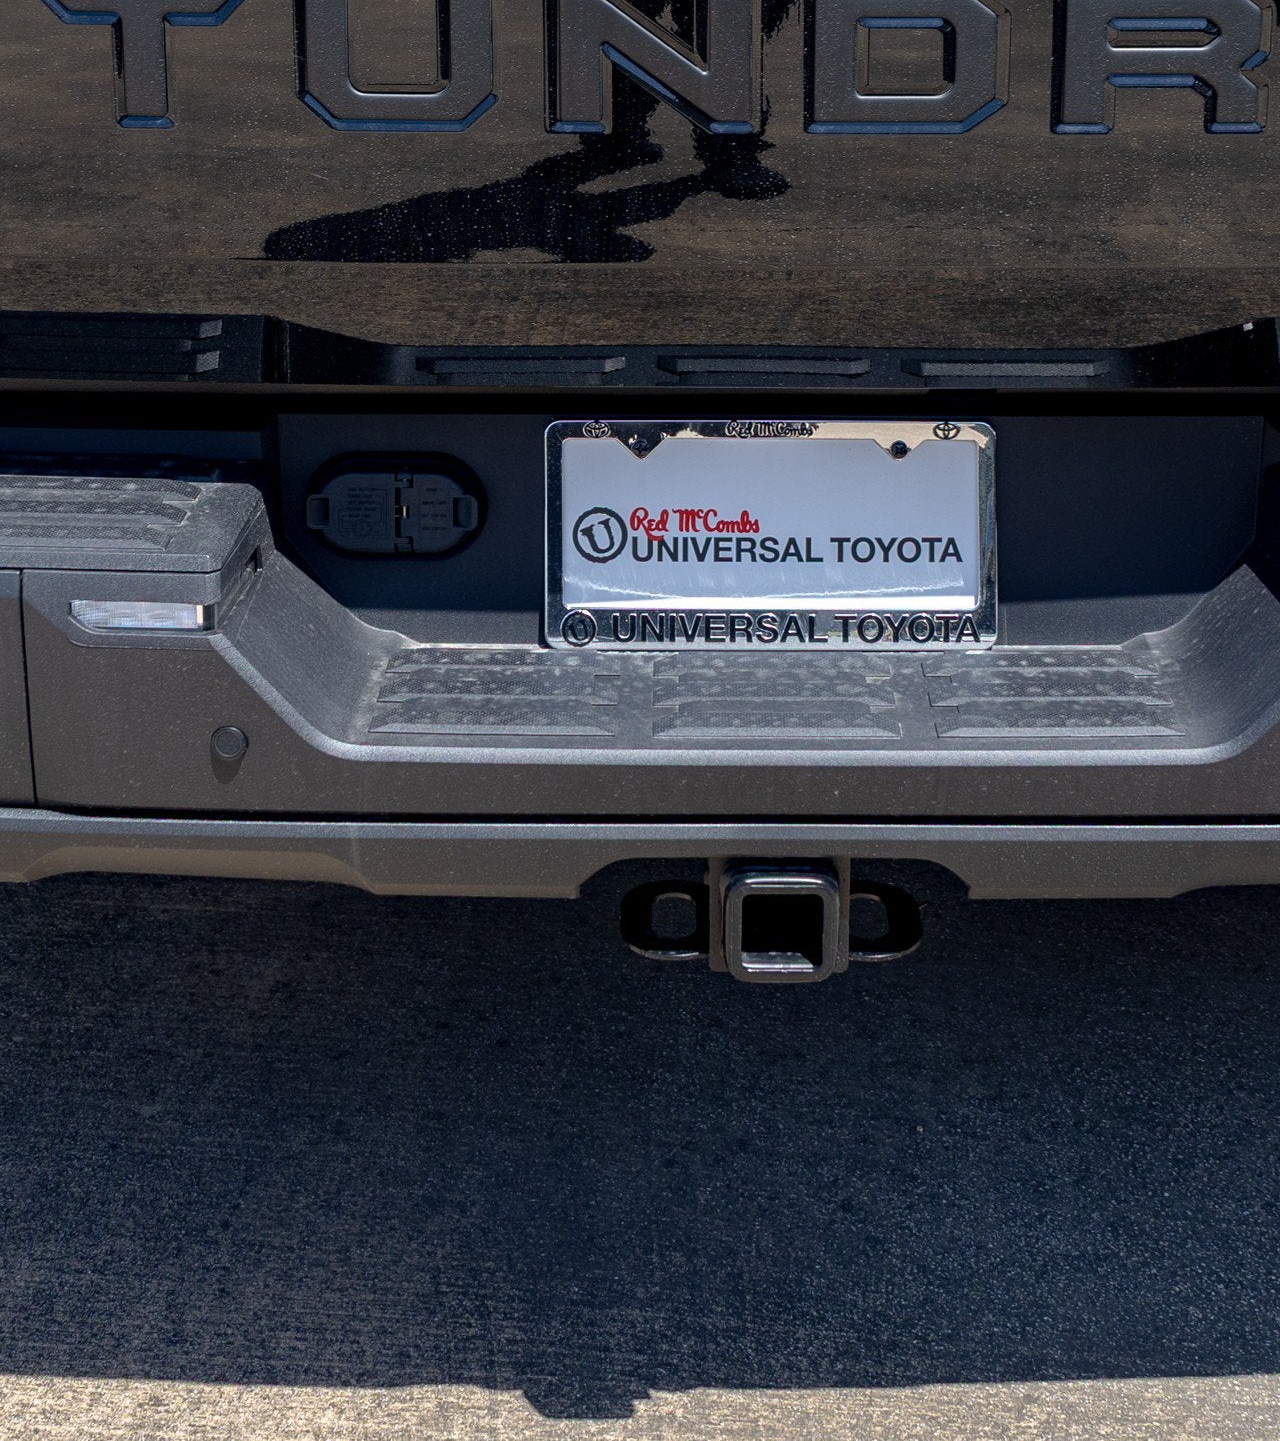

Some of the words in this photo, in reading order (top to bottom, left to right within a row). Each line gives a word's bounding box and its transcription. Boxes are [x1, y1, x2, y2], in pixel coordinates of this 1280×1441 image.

[724, 419, 754, 439] Red
[629, 507, 669, 541] Red
[672, 508, 760, 534] McCombs
[631, 535, 824, 564] UNIVERSAL
[829, 535, 964, 564] TOYOTA
[611, 612, 828, 644] UNIVERSAL
[834, 612, 982, 644] TOYOTA
